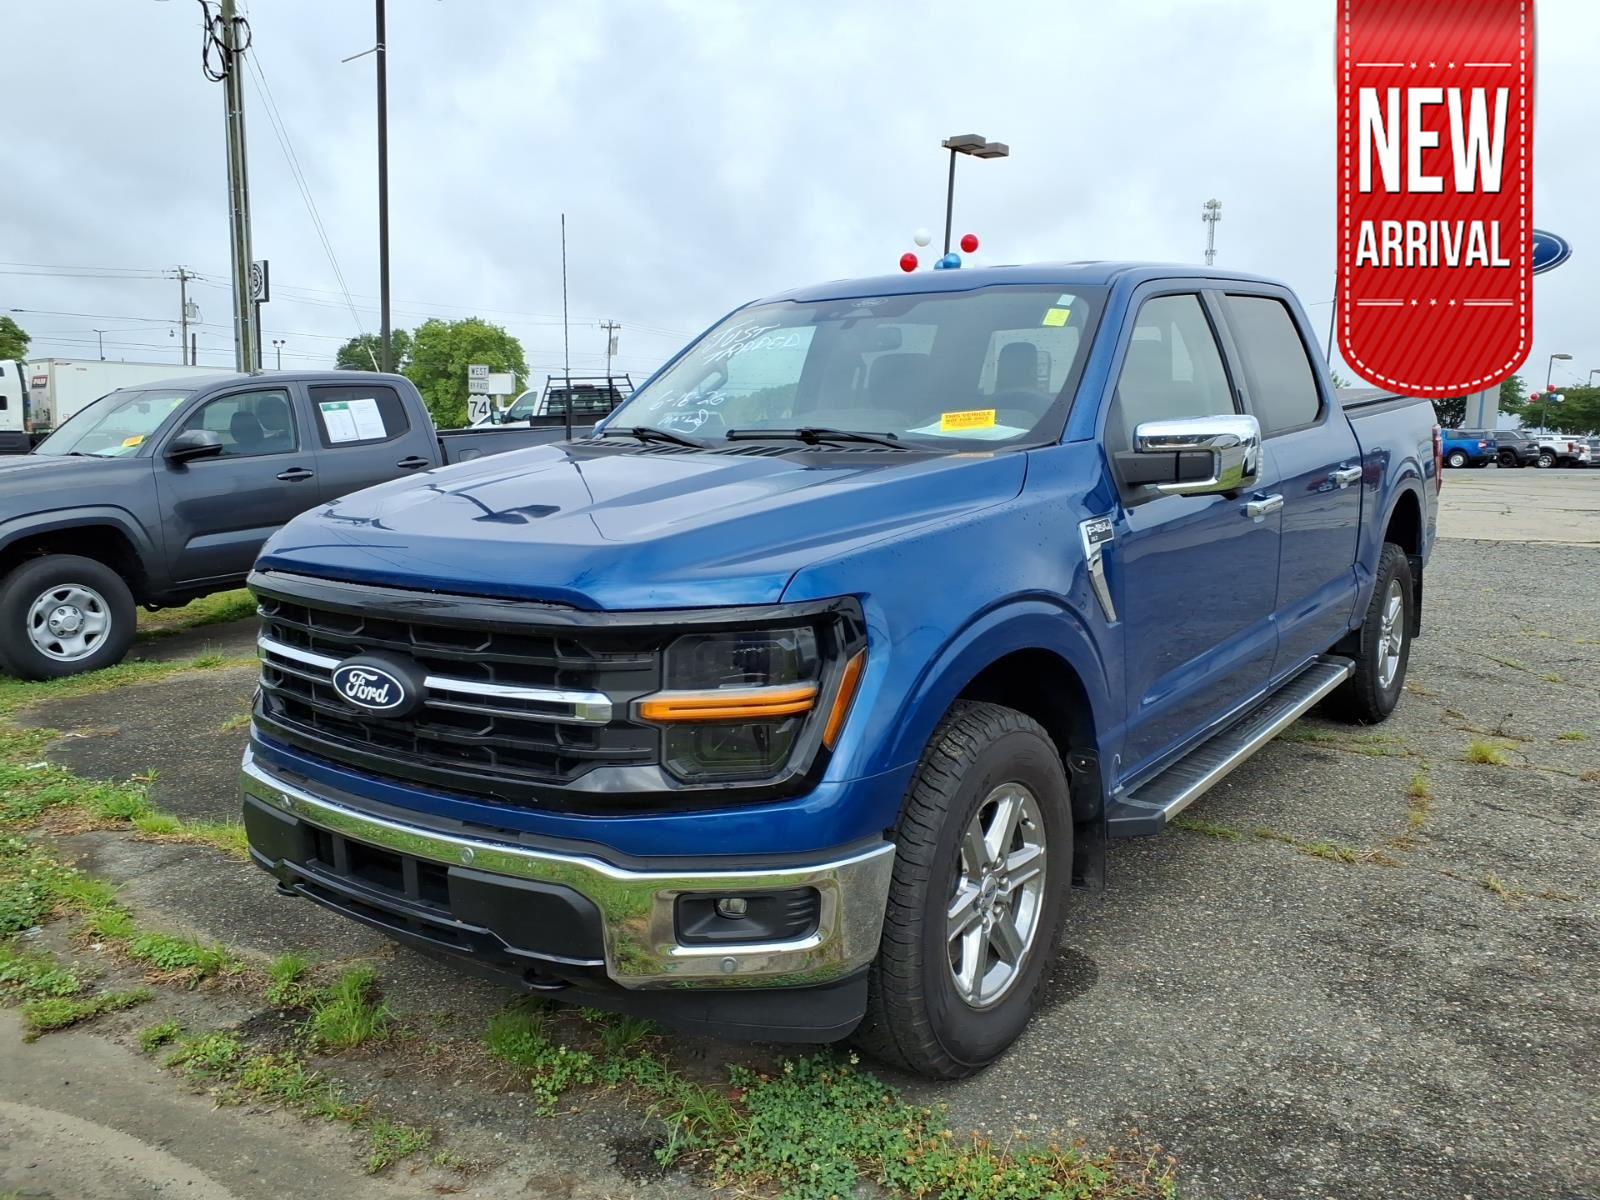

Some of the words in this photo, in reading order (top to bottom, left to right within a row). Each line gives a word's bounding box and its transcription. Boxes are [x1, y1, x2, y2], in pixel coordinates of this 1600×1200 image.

[702, 319, 781, 353] JUST
[471, 367, 487, 376] WEST
[470, 401, 488, 418] 74
[345, 669, 390, 704] Ford
